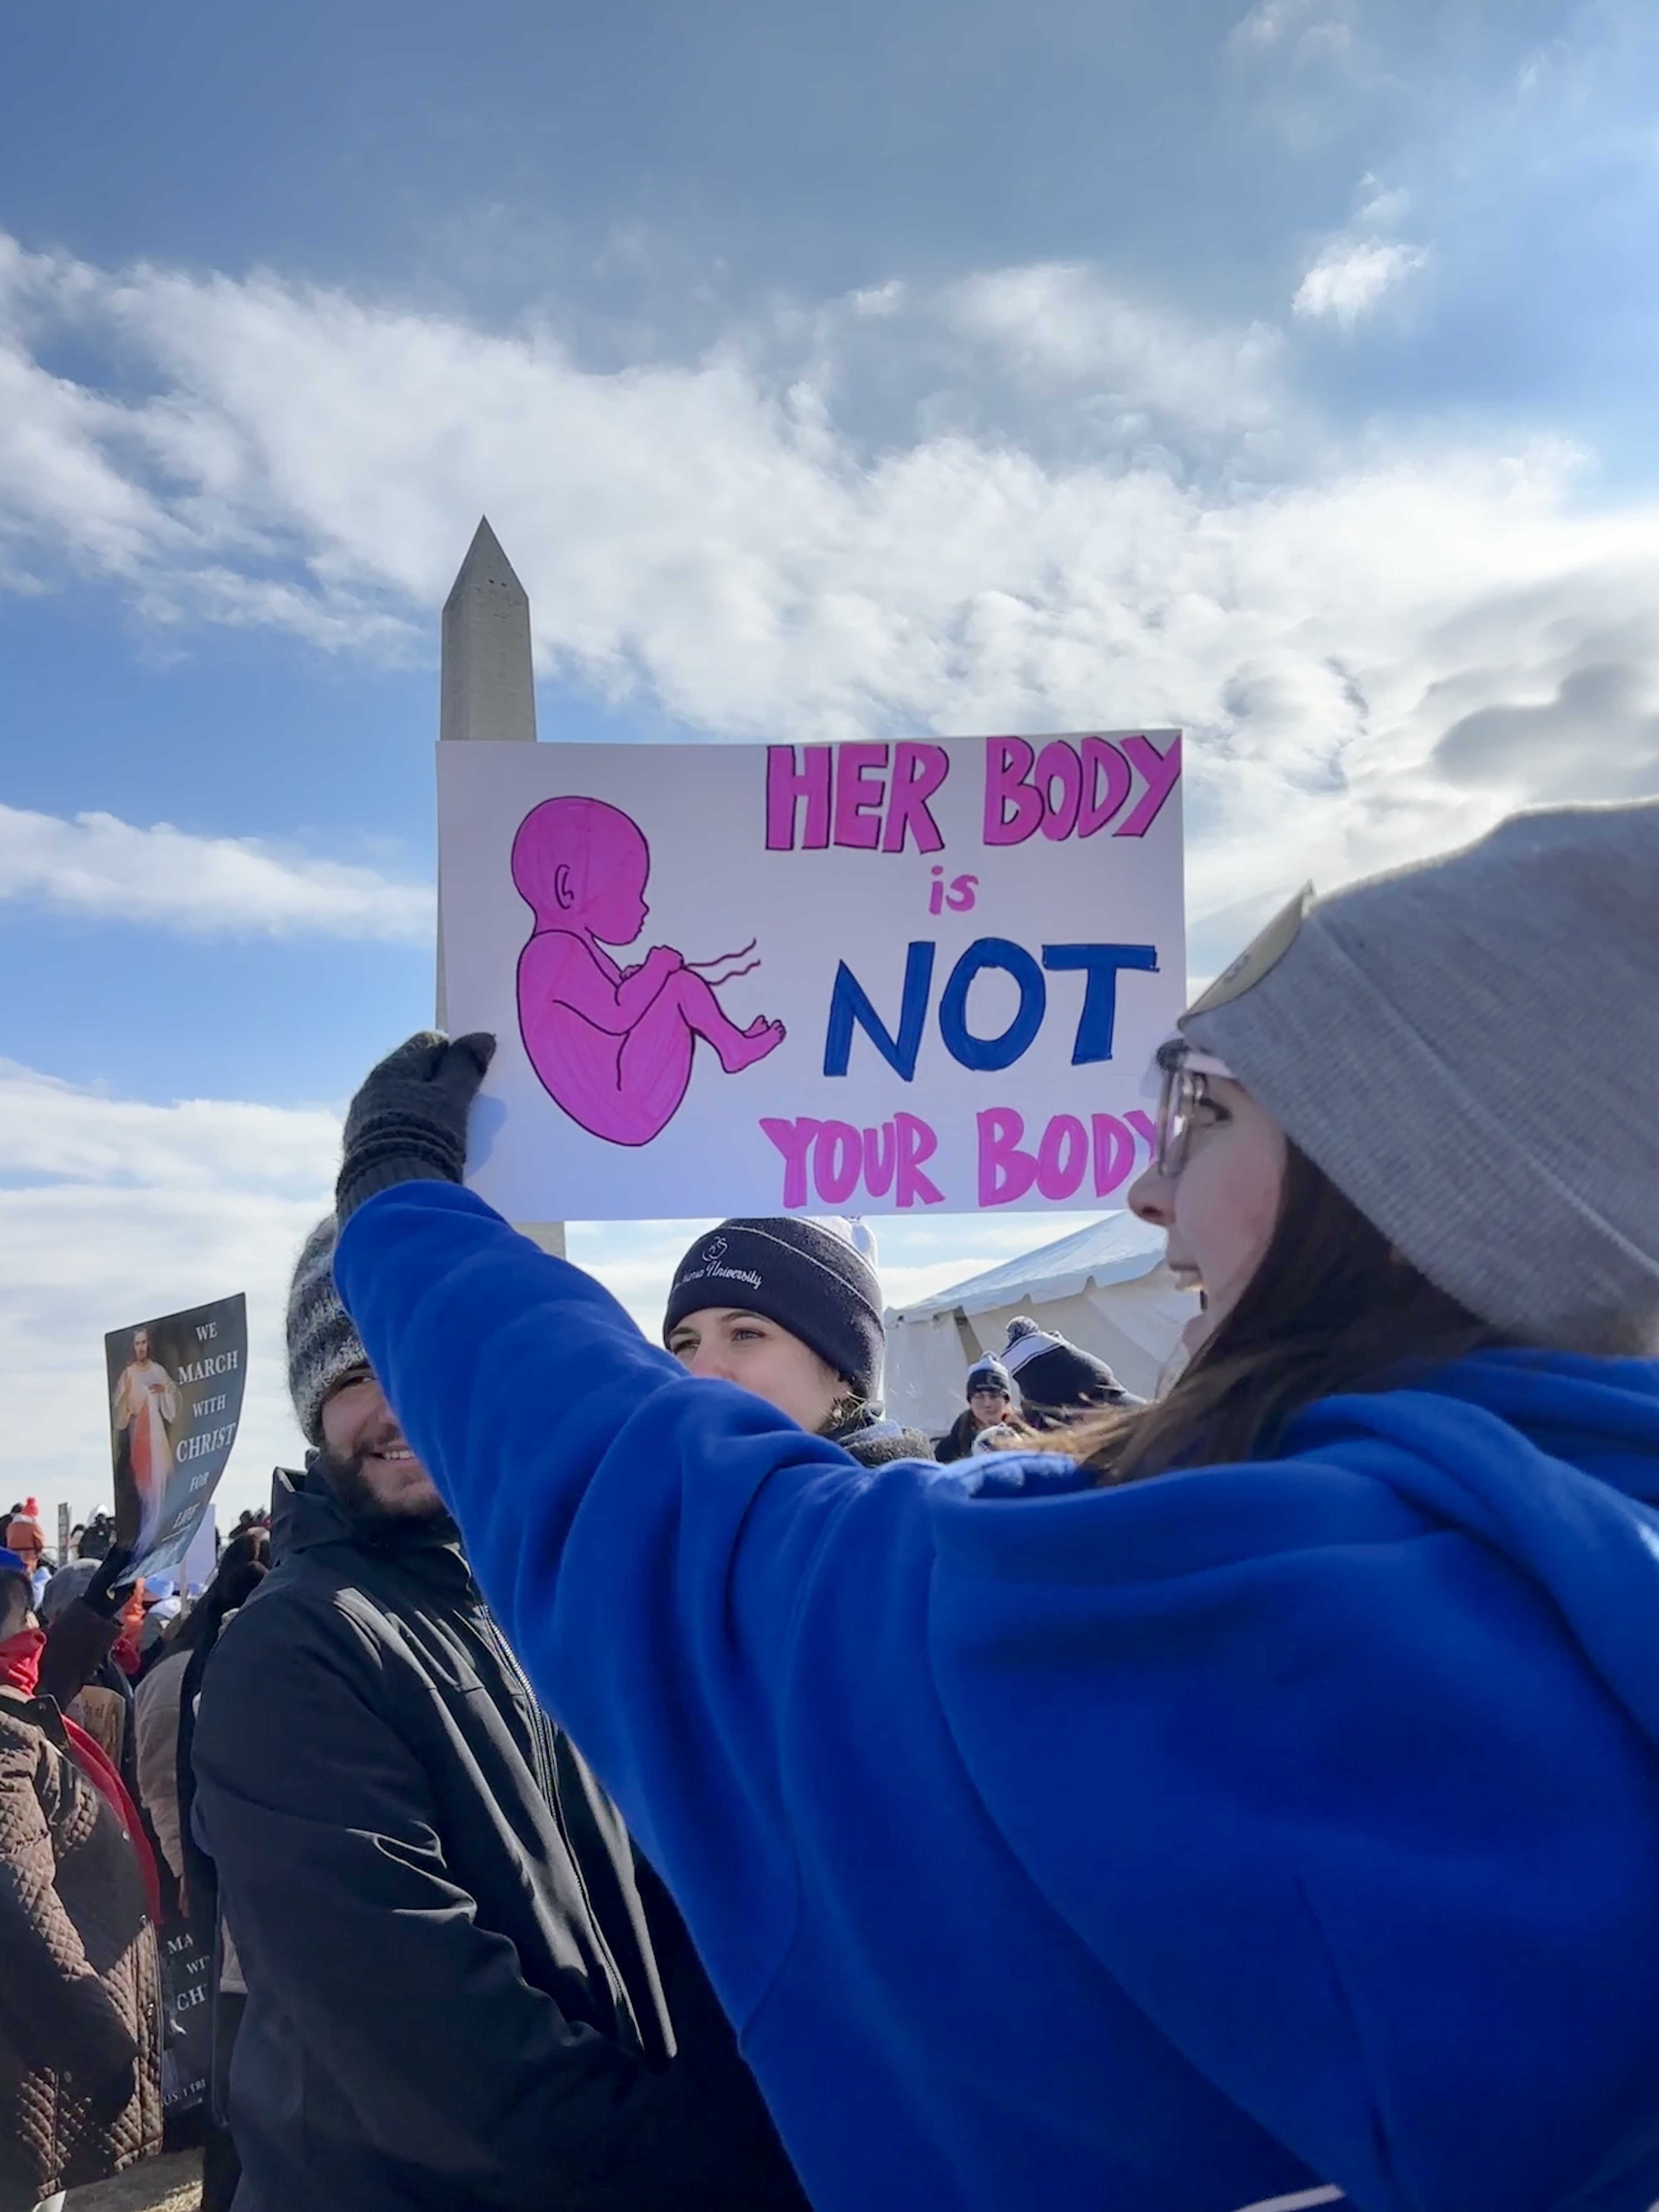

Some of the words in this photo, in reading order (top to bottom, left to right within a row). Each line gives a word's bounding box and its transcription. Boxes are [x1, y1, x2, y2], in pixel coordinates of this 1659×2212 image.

[766, 742, 950, 855] HER
[983, 736, 1182, 847] BODY
[929, 866, 979, 915] is
[823, 938, 1159, 1082] NOT
[759, 1111, 945, 1209] YOUR
[195, 1322, 218, 1342] WE
[177, 1350, 238, 1385] MARCH
[192, 1394, 227, 1418] WITH
[176, 1422, 237, 1463] CHRIST
[189, 1471, 210, 1492] FOR
